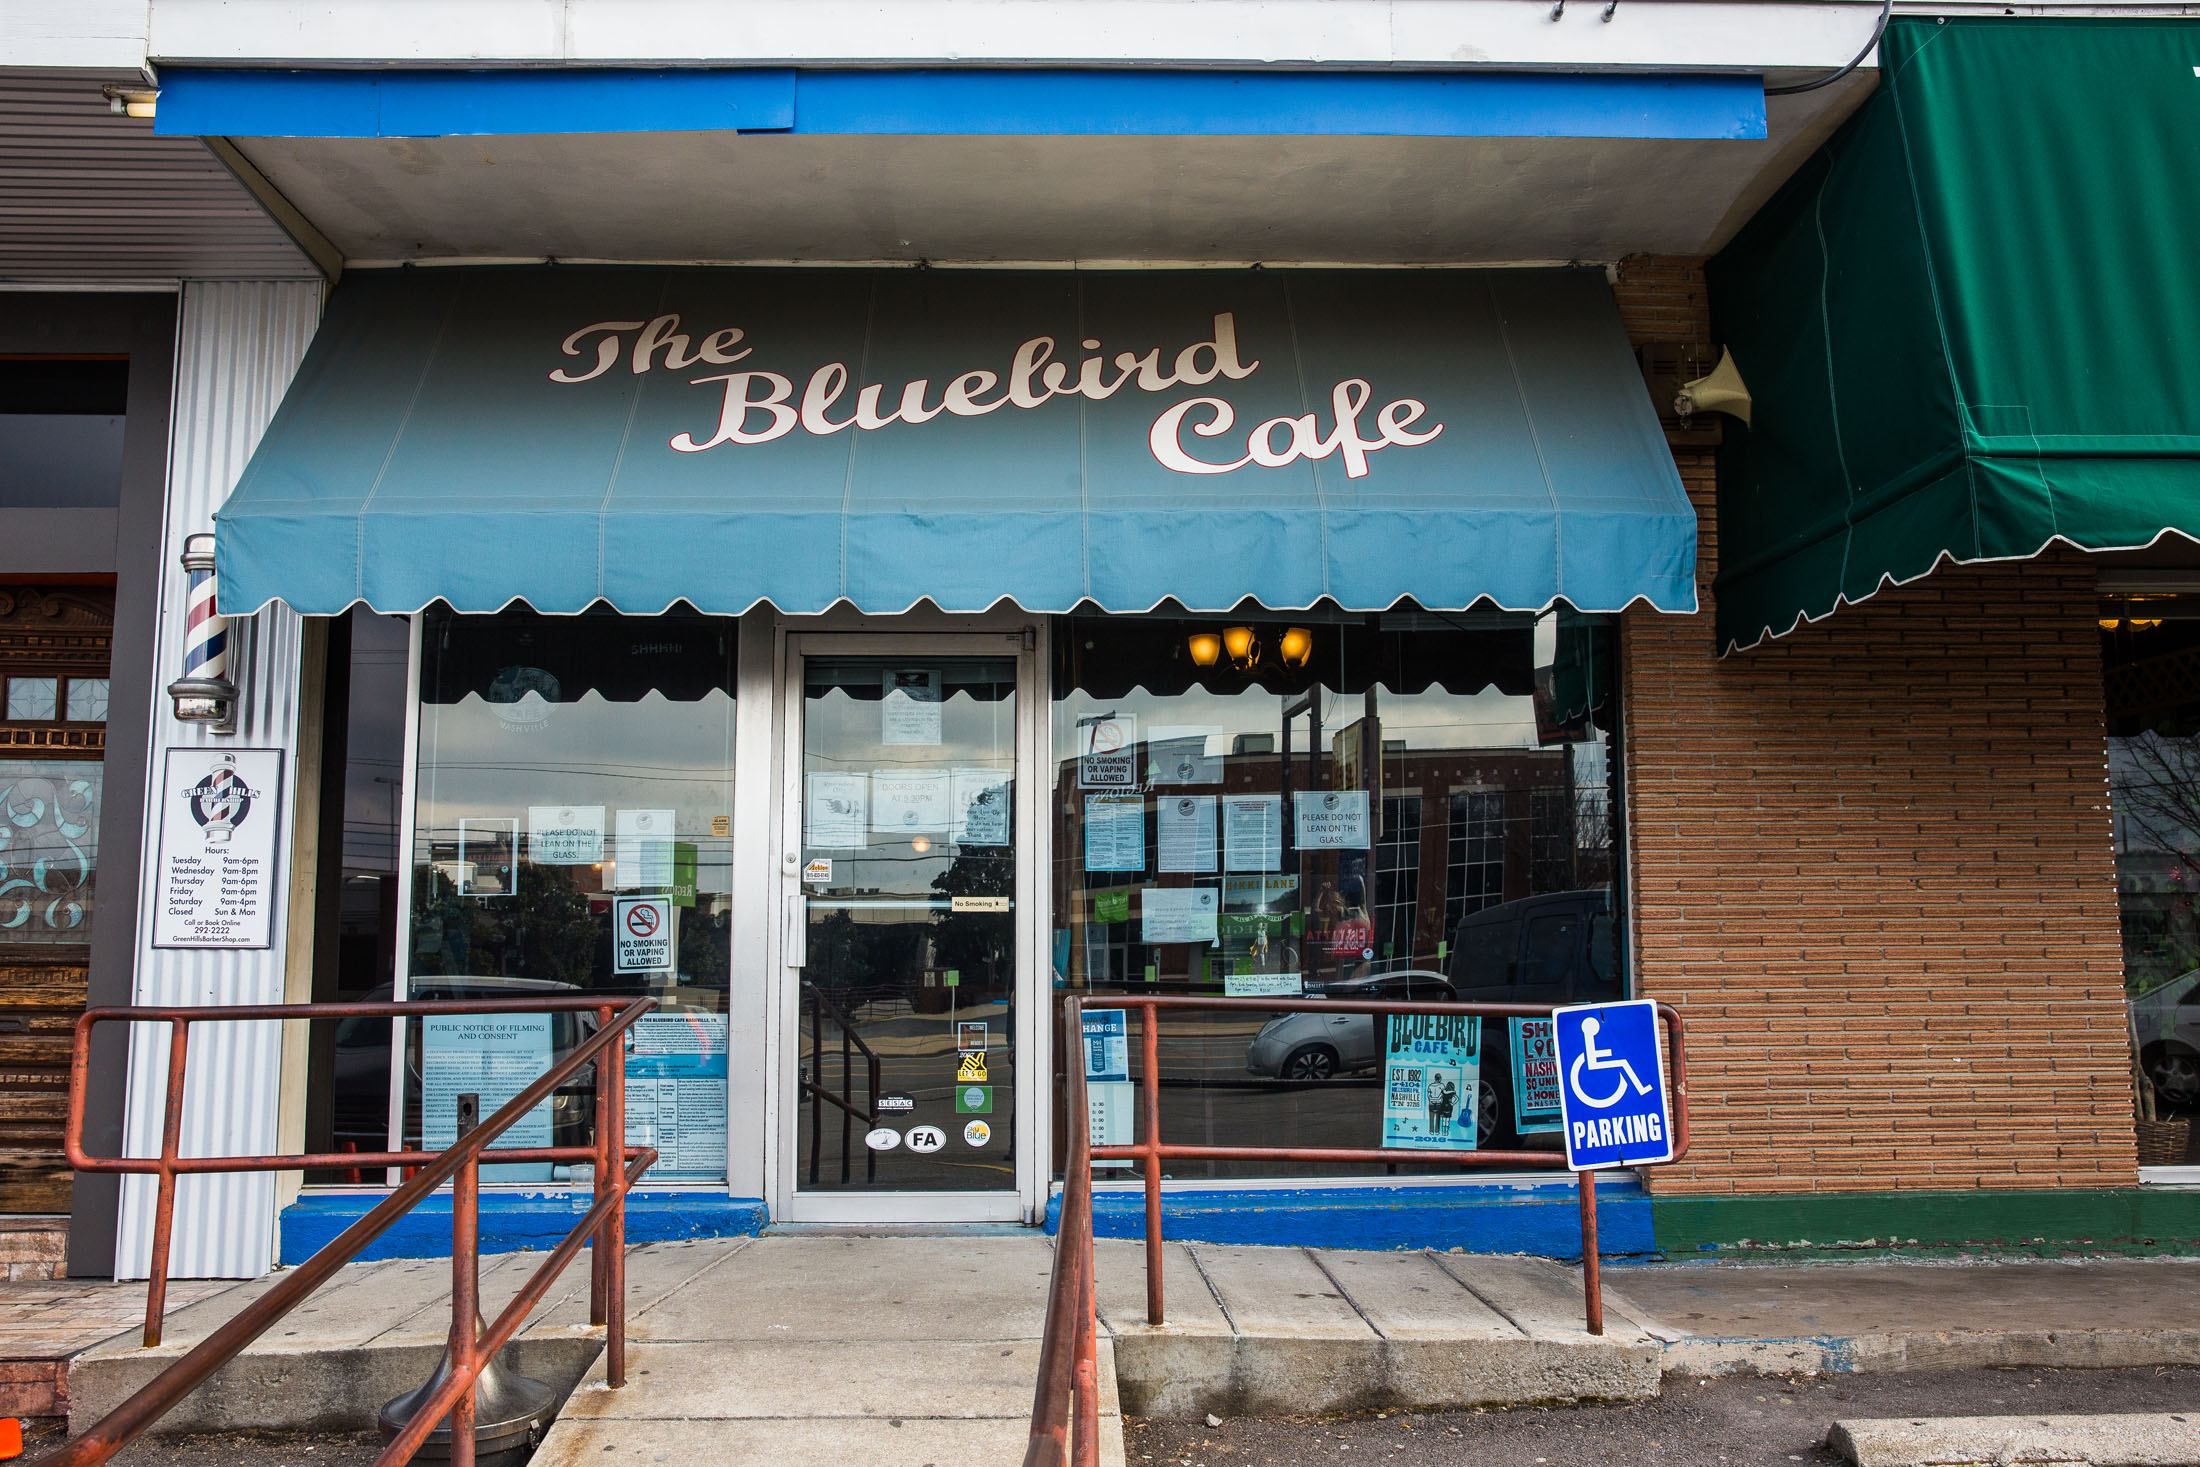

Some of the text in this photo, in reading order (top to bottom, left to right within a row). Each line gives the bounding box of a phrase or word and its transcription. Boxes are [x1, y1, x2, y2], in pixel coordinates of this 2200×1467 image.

[548, 313, 753, 383] The
[668, 311, 1260, 453] Bluebird
[1148, 378, 1445, 480] Cafe
[1084, 757, 1131, 765] NO SMOKING
[1089, 774, 1125, 782] ALLOWED
[882, 783, 938, 791] DOORS OPEN
[181, 786, 261, 799] GREEN HILLS
[1302, 813, 1361, 821] PLEASE DO NOT
[536, 828, 596, 836] PLEASE DO NOT
[1342, 824, 1358, 832] THE
[541, 840, 592, 848] LEAN ON THE
[205, 846, 230, 854] Hours:
[172, 856, 259, 866] Tuesday 9am-6pm
[171, 866, 258, 876] Wednesday 9am-8pm
[171, 877, 257, 886] Thursday 9am-6pm
[1266, 879, 1295, 889] LANE
[170, 887, 257, 897] Friday 9am-6pm
[169, 897, 256, 907] Saturday 9am-4pm
[239, 908, 256, 916] Mon
[172, 935, 251, 943] GreenHillsBarberShop.com
[620, 939, 668, 948] NO SMOKING
[624, 948, 664, 957] OR VAPING
[626, 957, 662, 966] ALLOWED
[1521, 1021, 1553, 1039] SH
[1390, 1015, 1478, 1057] BLUEBIRD
[1414, 1040, 1449, 1054] CAFE
[1391, 1068, 1421, 1082] EST. 1982
[1391, 1092, 1420, 1101] NASHVILLE
[1526, 1091, 1532, 1100] &
[879, 1099, 913, 1107] SESAC
[966, 1126, 980, 1134] Sky
[1572, 1112, 1663, 1150] PARKING
[912, 1132, 938, 1146] FA
[966, 1131, 987, 1140] Blue
